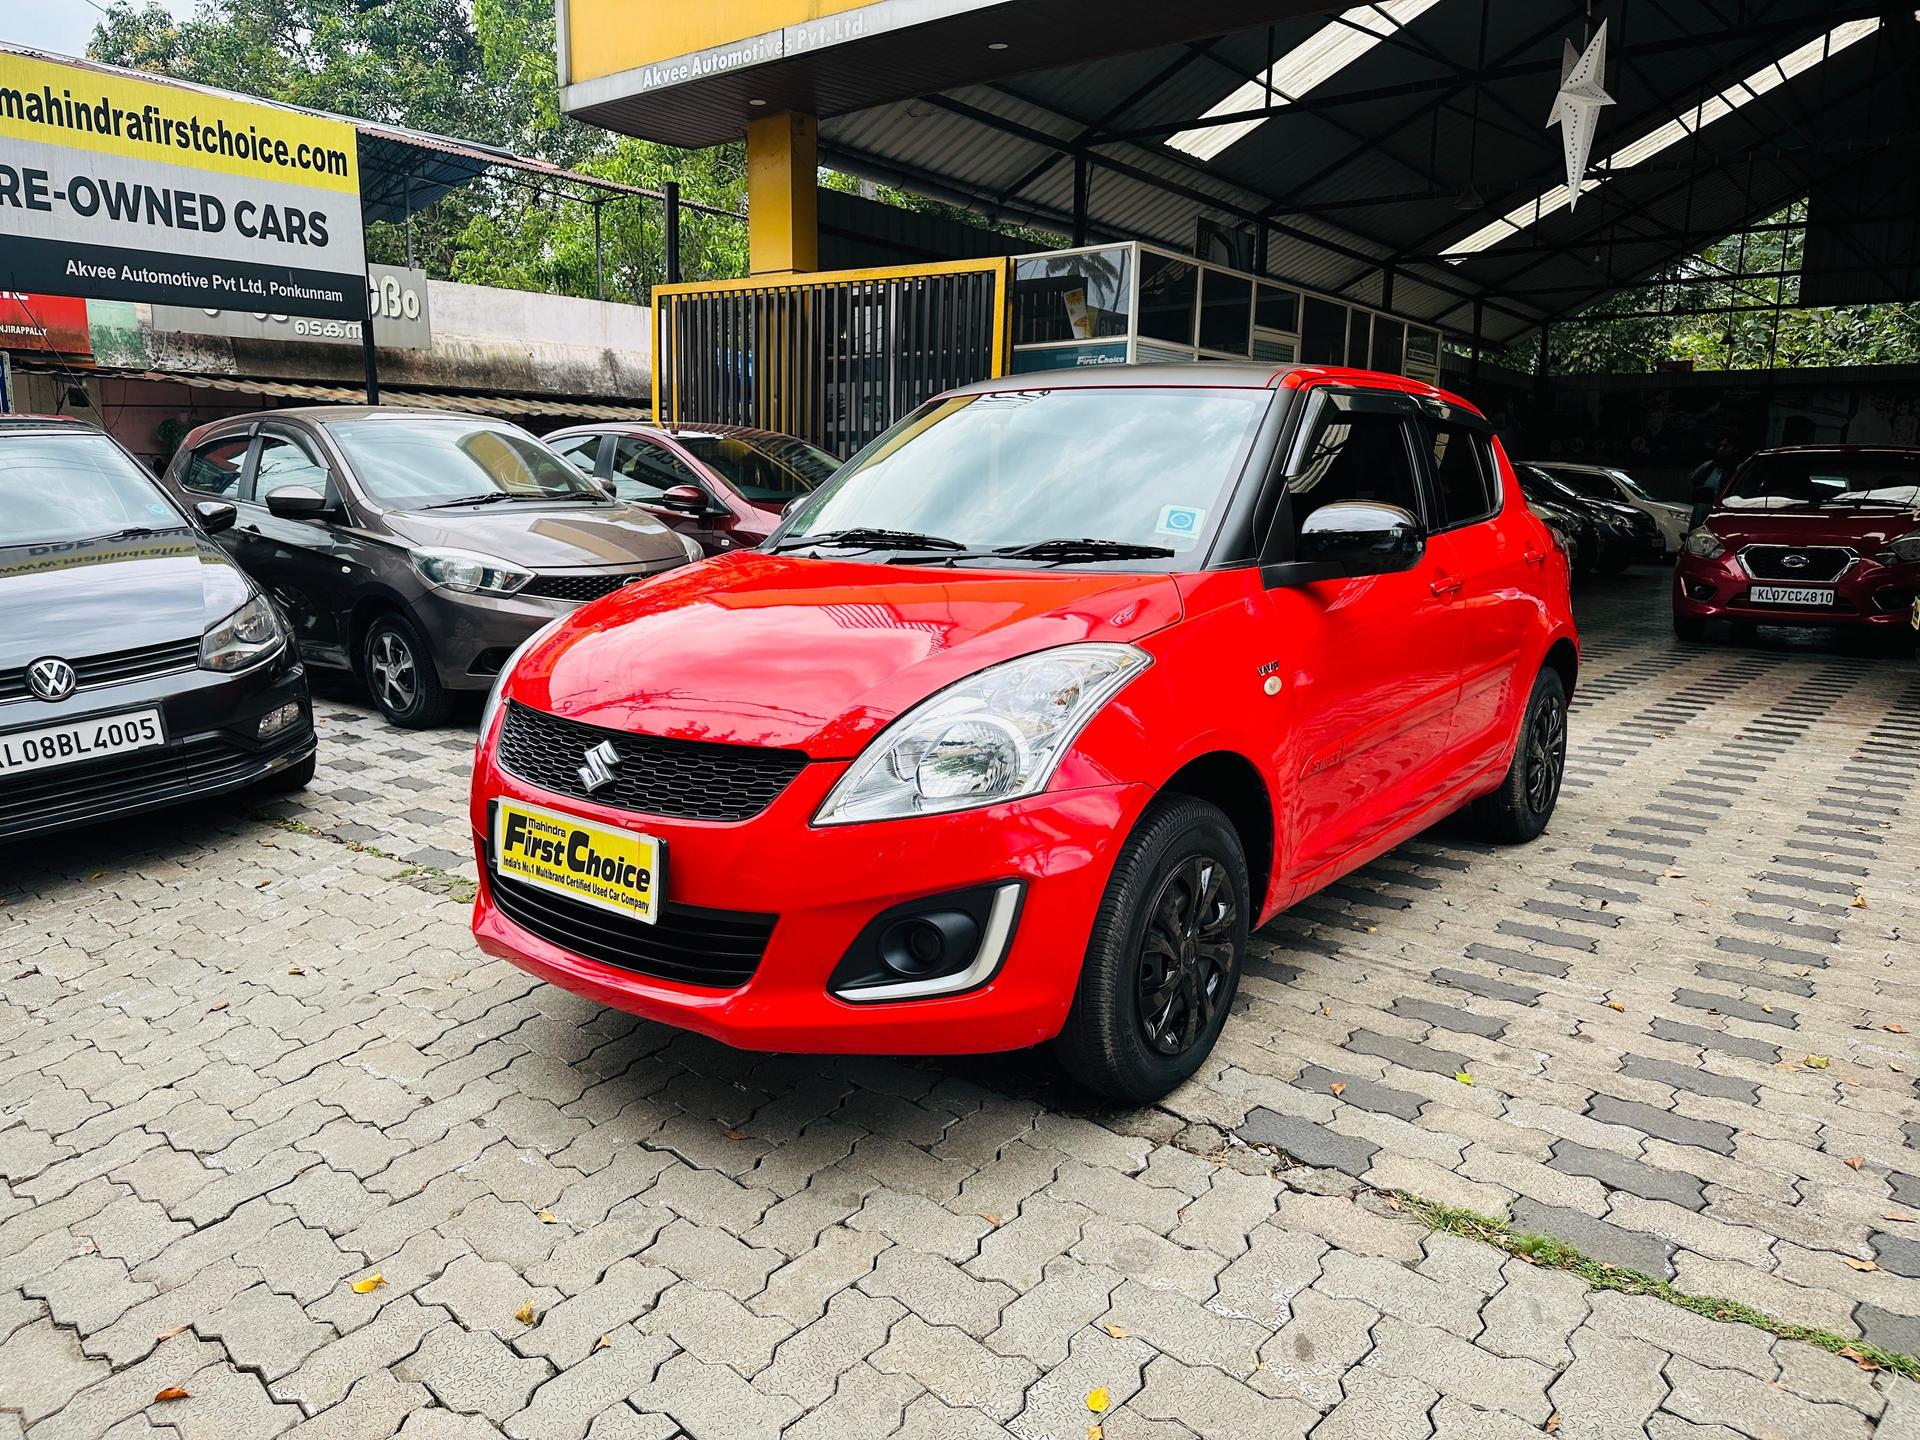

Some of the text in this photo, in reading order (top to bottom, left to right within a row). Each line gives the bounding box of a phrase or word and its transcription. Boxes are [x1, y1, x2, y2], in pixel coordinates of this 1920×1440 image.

[643, 13, 868, 89] Akvee Automotives Pvt. Ltd.
[0, 86, 347, 176] mahindrafirstchoice.com
[0, 163, 329, 247] RE-OWNED CARS
[66, 259, 343, 303] Akvee Automotive Pvt Ltd, Ponkunnam
[1757, 589, 1833, 603] KL07CC4810
[0, 717, 156, 769] L08BL4005
[503, 855, 521, 869] India's
[536, 865, 565, 885] Multibrand
[566, 875, 591, 892] Certified
[592, 884, 608, 898] Used
[609, 888, 620, 901] Car
[621, 893, 650, 914] Company
